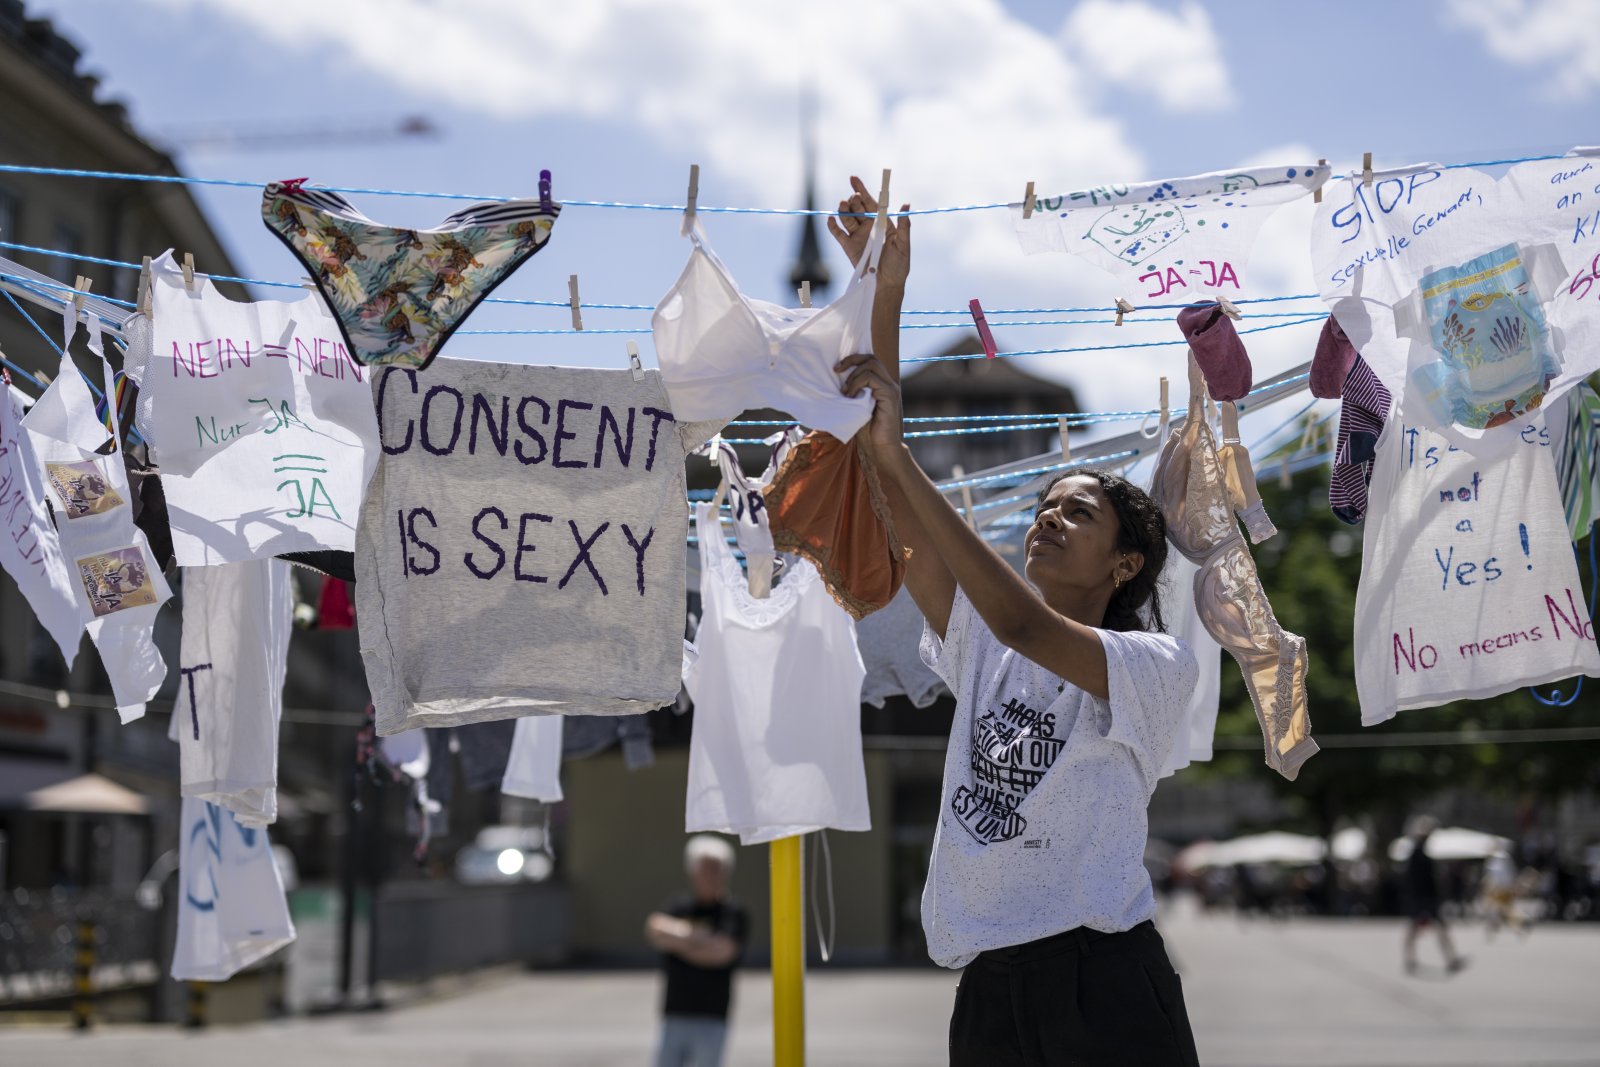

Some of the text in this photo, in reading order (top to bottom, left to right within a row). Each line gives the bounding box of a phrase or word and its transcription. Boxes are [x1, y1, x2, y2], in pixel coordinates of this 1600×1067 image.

[1331, 171, 1441, 244] STOP
[1557, 192, 1582, 209] an
[172, 338, 251, 378] NEIN
[295, 337, 362, 383] NEIN
[196, 398, 314, 447] Nur JA
[376, 366, 676, 472] CONSENT
[277, 478, 342, 520] JA
[1456, 519, 1473, 532] a
[398, 506, 656, 597] IS SEXY
[1393, 627, 1438, 675] No
[1459, 625, 1543, 659] means
